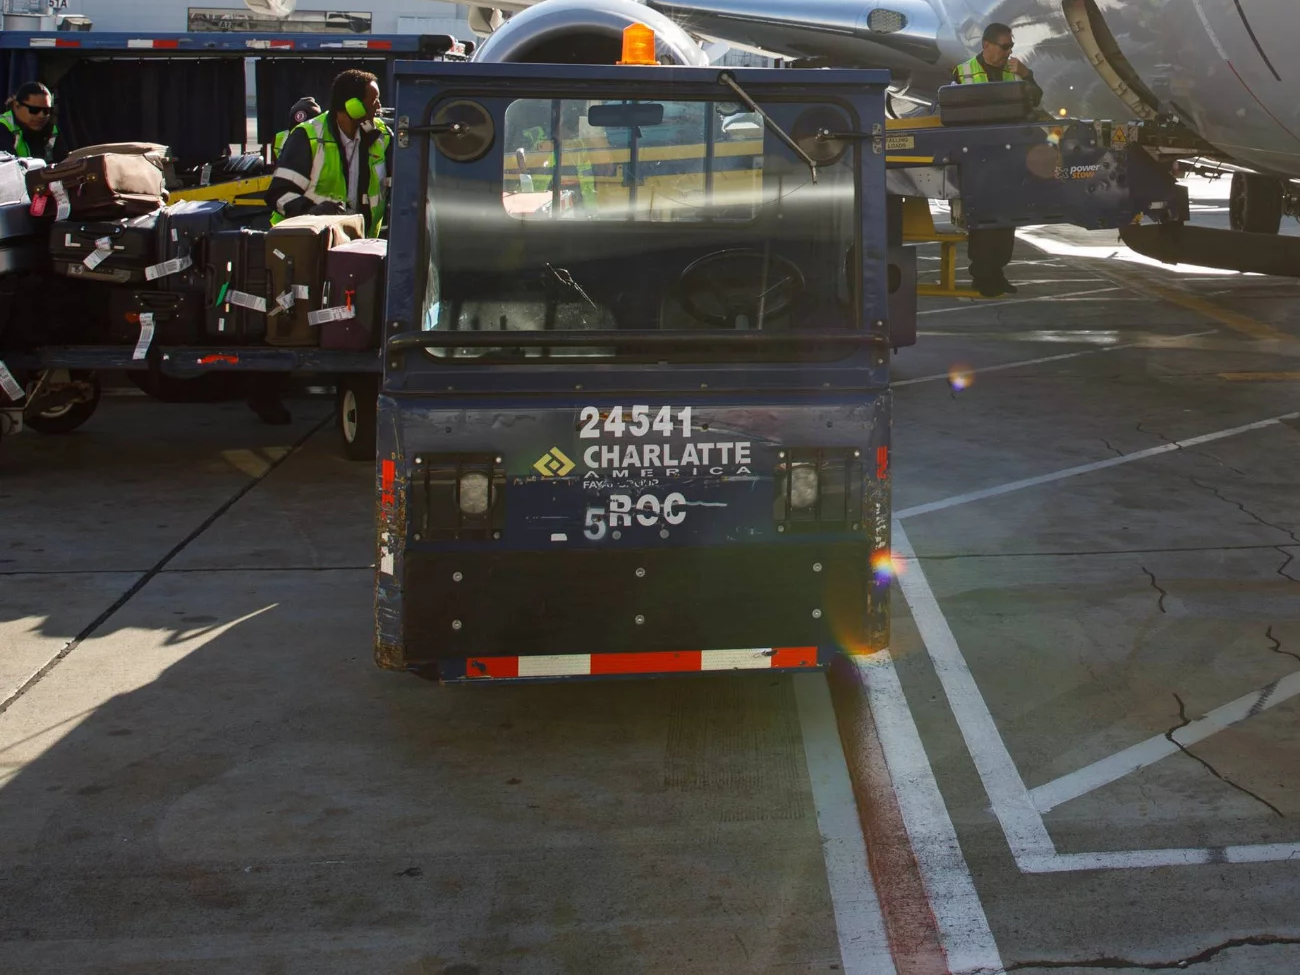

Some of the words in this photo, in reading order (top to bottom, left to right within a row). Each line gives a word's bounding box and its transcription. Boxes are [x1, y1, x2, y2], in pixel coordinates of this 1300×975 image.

[1070, 164, 1100, 174] power
[1072, 171, 1096, 179] stow
[579, 405, 692, 439] 24541
[583, 441, 751, 468] CHARLATTE
[583, 466, 752, 479] AMERICA
